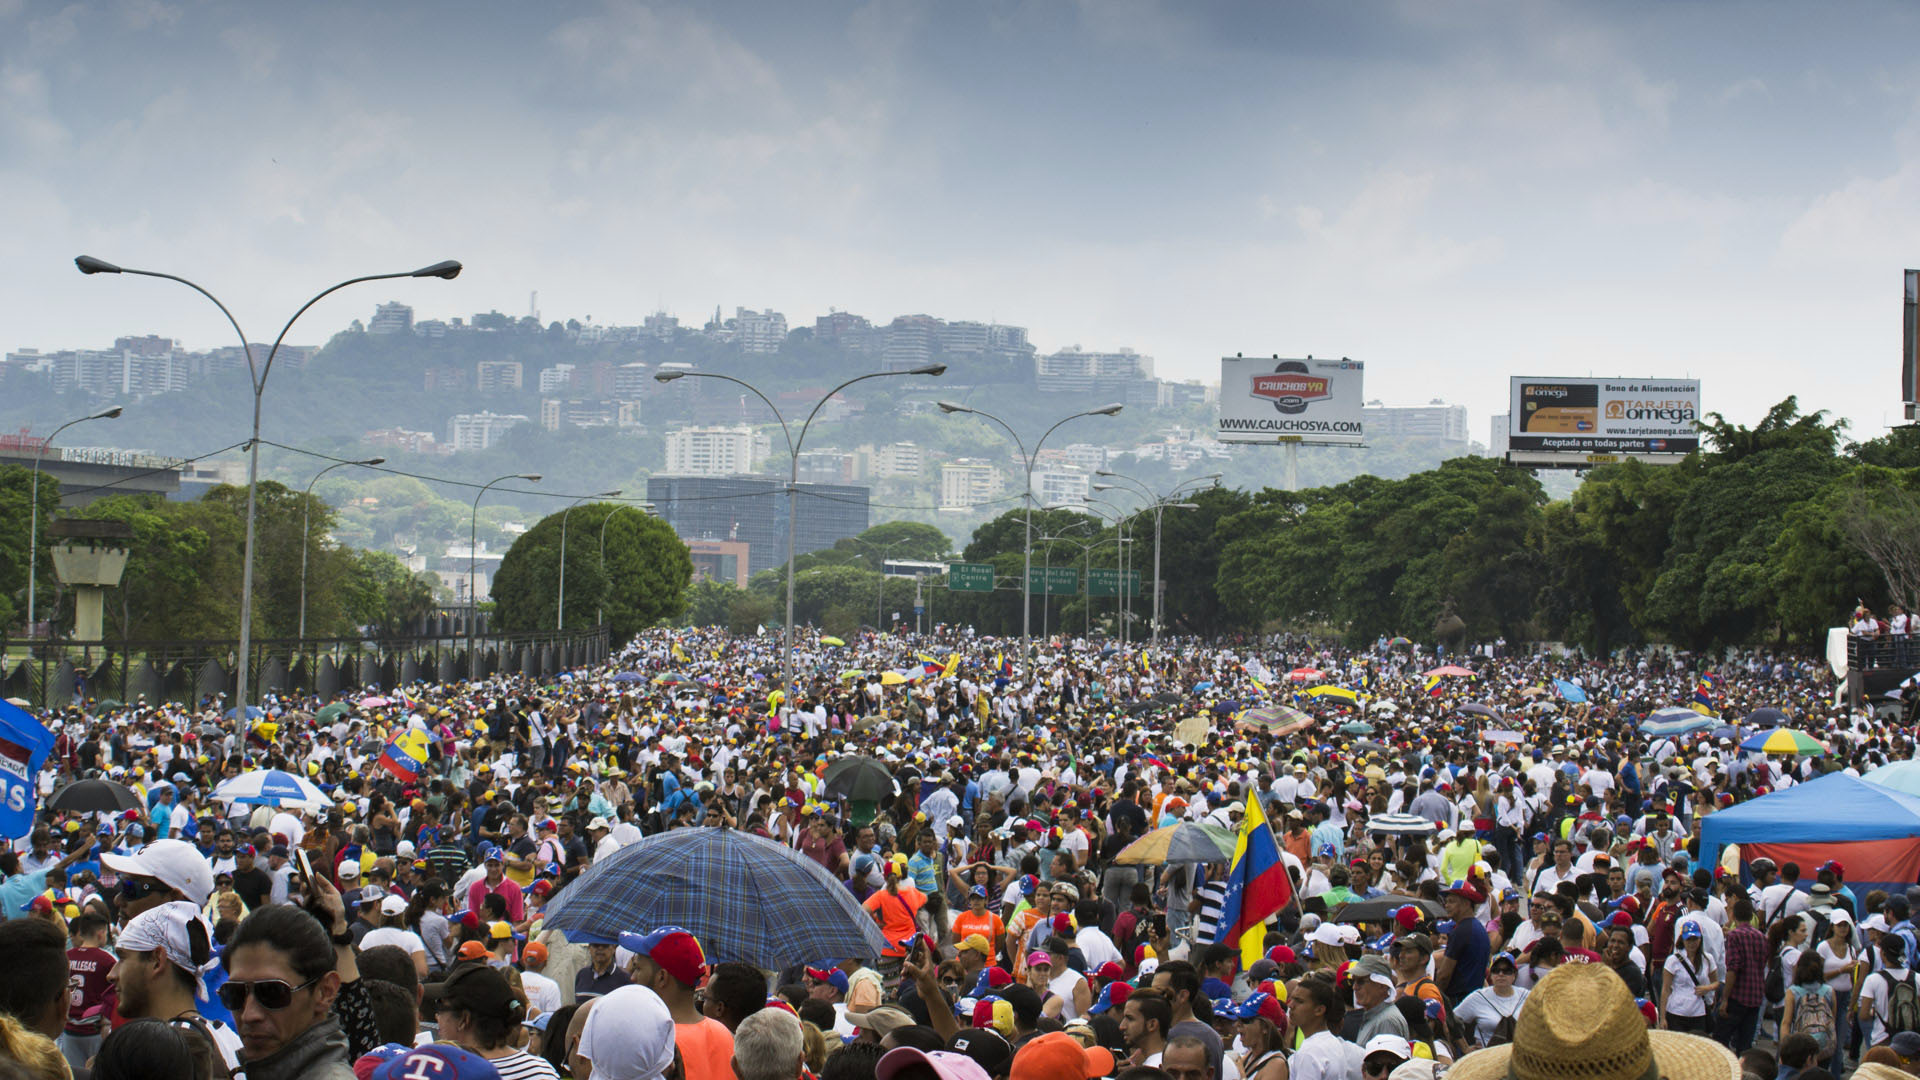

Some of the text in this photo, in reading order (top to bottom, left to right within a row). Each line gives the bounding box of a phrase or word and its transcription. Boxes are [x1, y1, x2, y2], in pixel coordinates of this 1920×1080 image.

[1605, 384, 1626, 392] Bono
[1629, 384, 1638, 392] de
[1534, 390, 1568, 398] omega
[1626, 400, 1694, 409] TARJETA
[1626, 408, 1695, 424] omega
[1220, 419, 1361, 432] WWW.CAUCHOSYA.COM
[1542, 438, 1580, 448] Aceptada
[1595, 439, 1618, 447] todas
[1619, 440, 1645, 449] partes
[403, 1053, 445, 1080] T
